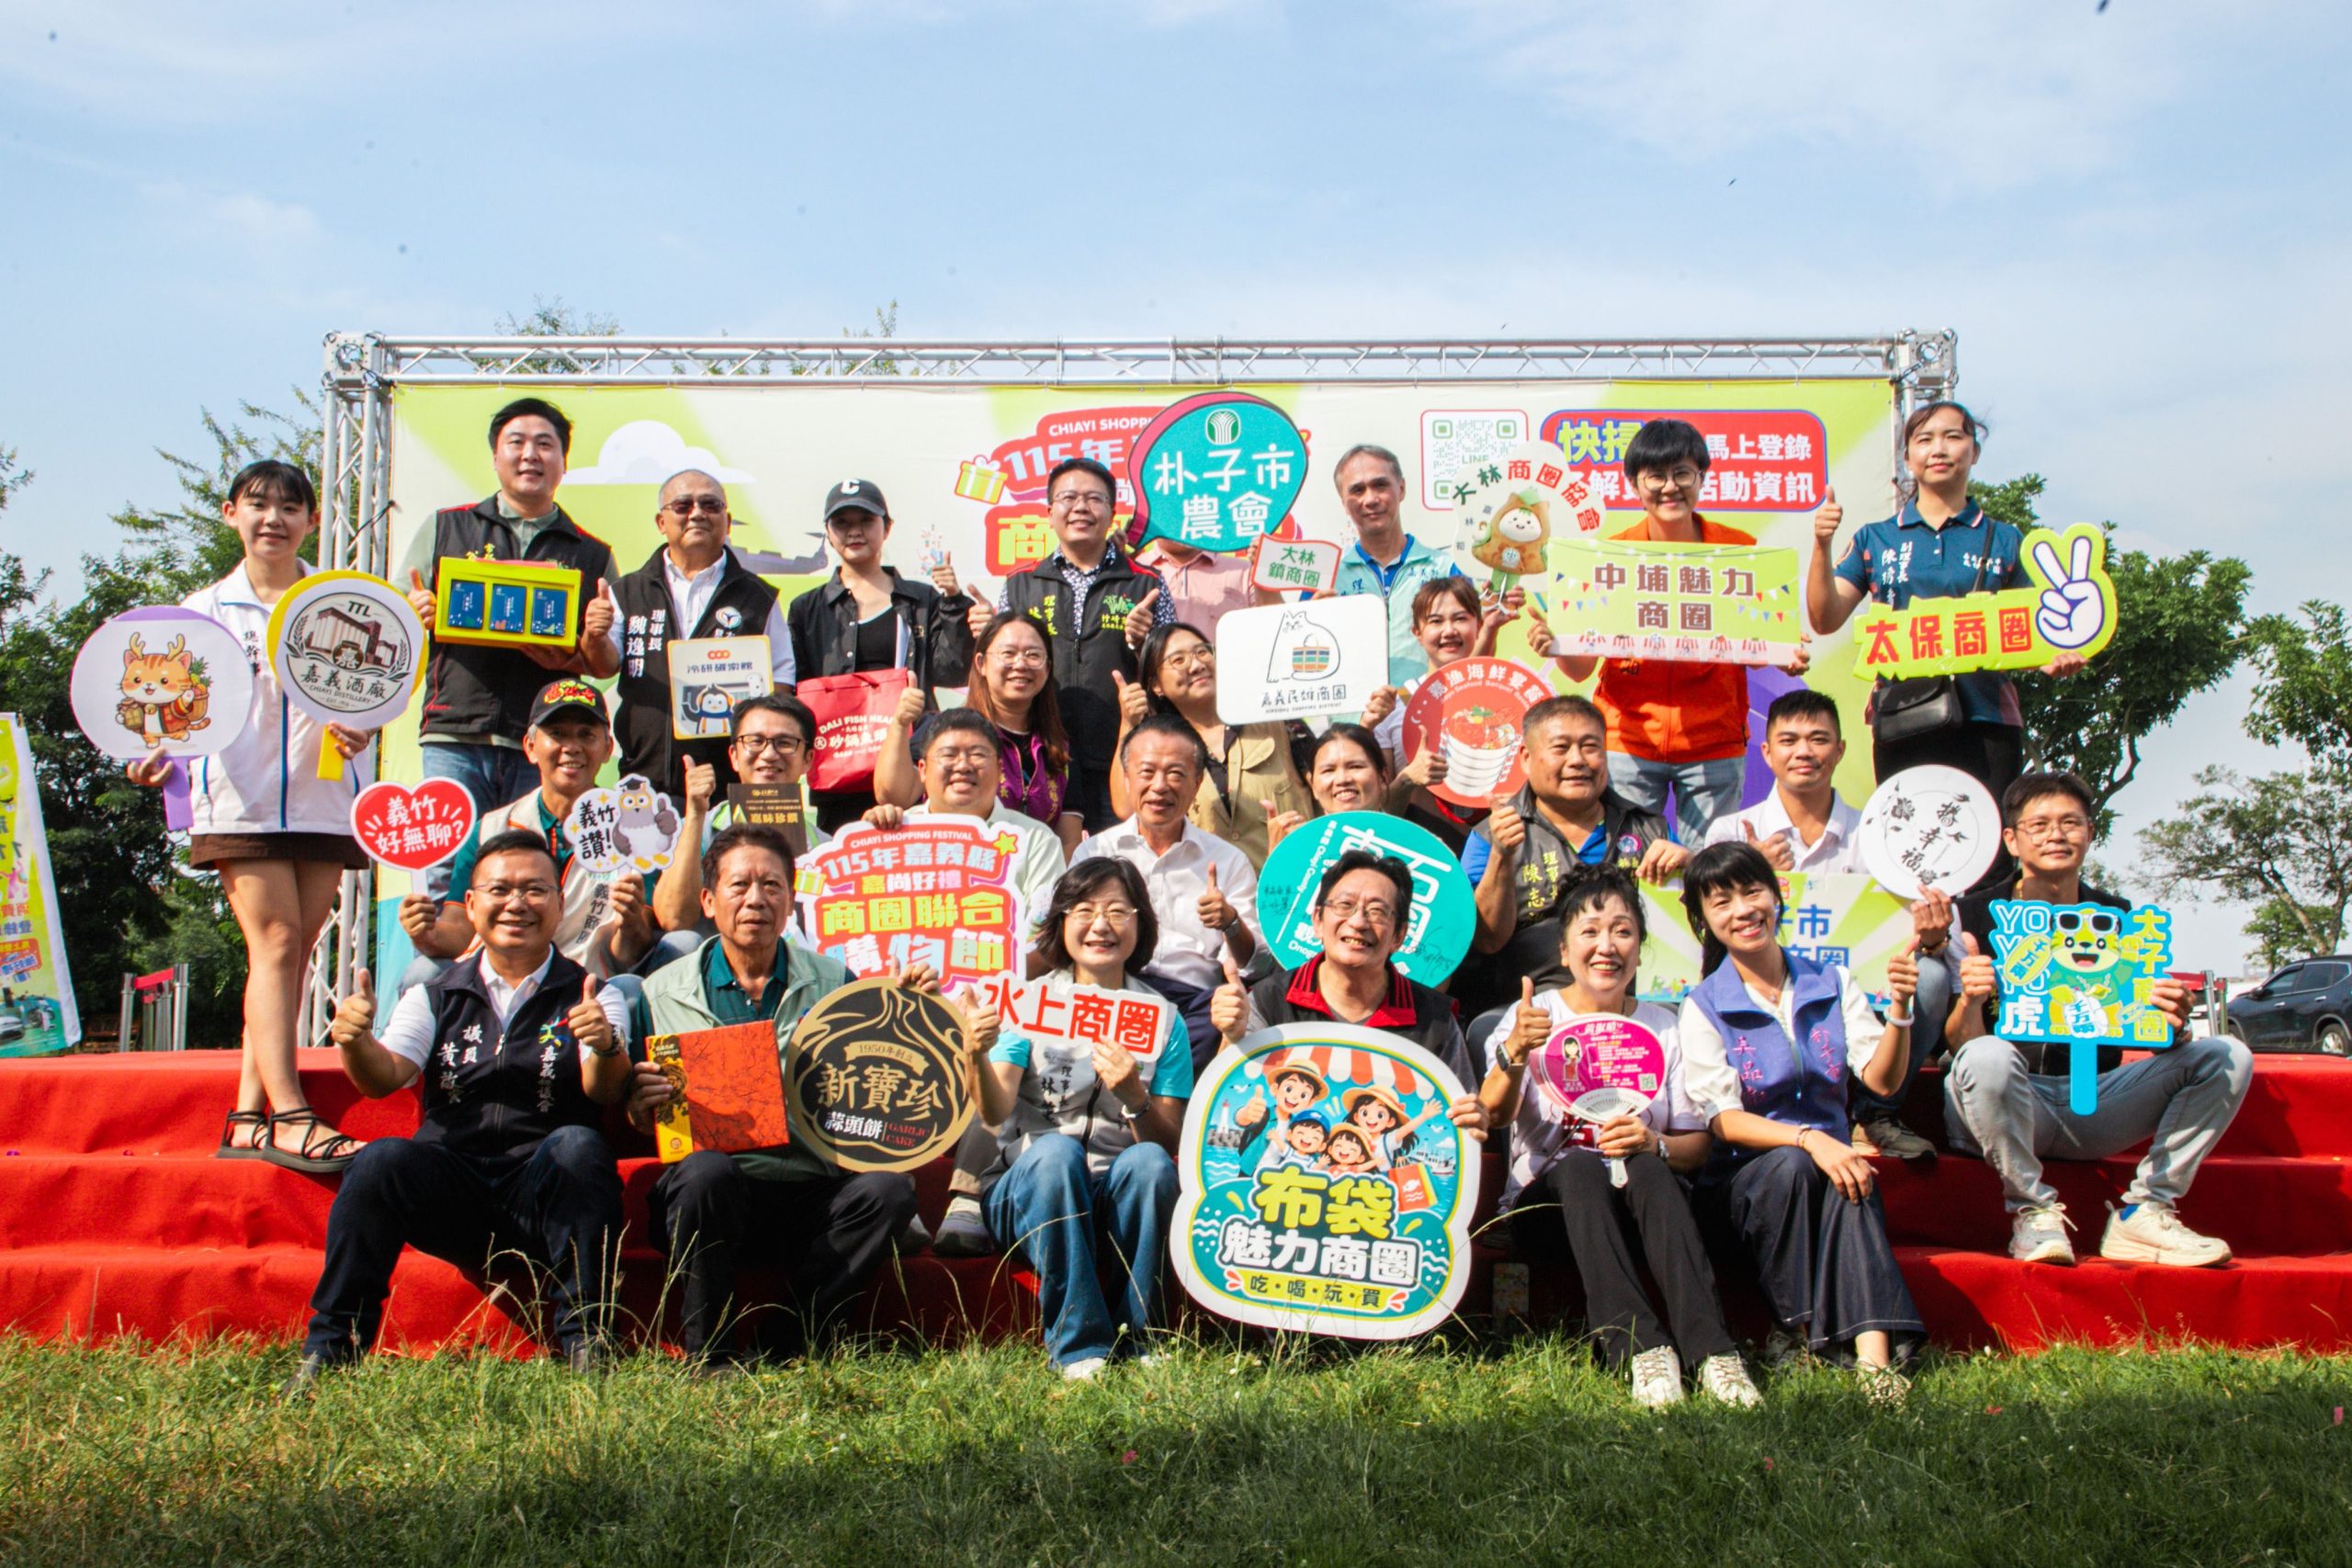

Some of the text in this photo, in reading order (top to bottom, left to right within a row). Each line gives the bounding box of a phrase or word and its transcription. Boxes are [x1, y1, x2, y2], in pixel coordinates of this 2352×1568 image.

[1048, 420, 1096, 436] CHIAYI
[1704, 434, 1812, 460] 馬上登錄
[840, 478, 860, 495] C
[1154, 444, 1295, 496] 朴子市
[1453, 460, 1600, 531] 大林商圈協會
[1180, 491, 1272, 540] 農會
[1281, 546, 1316, 566] 大林
[1268, 562, 1320, 588] 鎮商圈
[1594, 562, 1755, 596] 中埔魅力
[347, 601, 371, 617] TTL
[1636, 601, 1713, 631] 商圈
[627, 615, 648, 678] 魏逸明
[648, 609, 666, 651] 理事長
[1865, 606, 2033, 665] 太保商圈
[301, 663, 386, 699] 嘉義酒廠
[1261, 683, 1346, 707] 嘉義民雄商圈
[819, 718, 842, 734] DALI
[843, 715, 867, 725] FISH
[387, 795, 437, 827] 義竹
[580, 799, 616, 829] 義竹
[375, 819, 464, 855] 好無聊?
[579, 828, 612, 859] 讚!
[850, 830, 973, 849] CHIAYI SHOPPING FESTIVAL
[823, 842, 998, 879] 115年嘉義縣
[861, 870, 962, 895] 嘉尚好禮
[1521, 863, 1544, 917] 陳志
[822, 891, 1004, 936] 商圈聯合
[1995, 905, 2051, 934] YO
[825, 929, 1005, 979] 購物節
[984, 978, 1159, 1055] 水上商圈
[2000, 995, 2044, 1036] 虎
[462, 1023, 482, 1065] 議員
[816, 1063, 944, 1121] 新寶珍
[825, 1111, 882, 1139] 蒜頭餅
[886, 1134, 916, 1147] CAKE
[888, 1122, 929, 1136] GARLIC
[1256, 1166, 1393, 1238] 布袋
[1222, 1222, 1419, 1285] 魅力商圈
